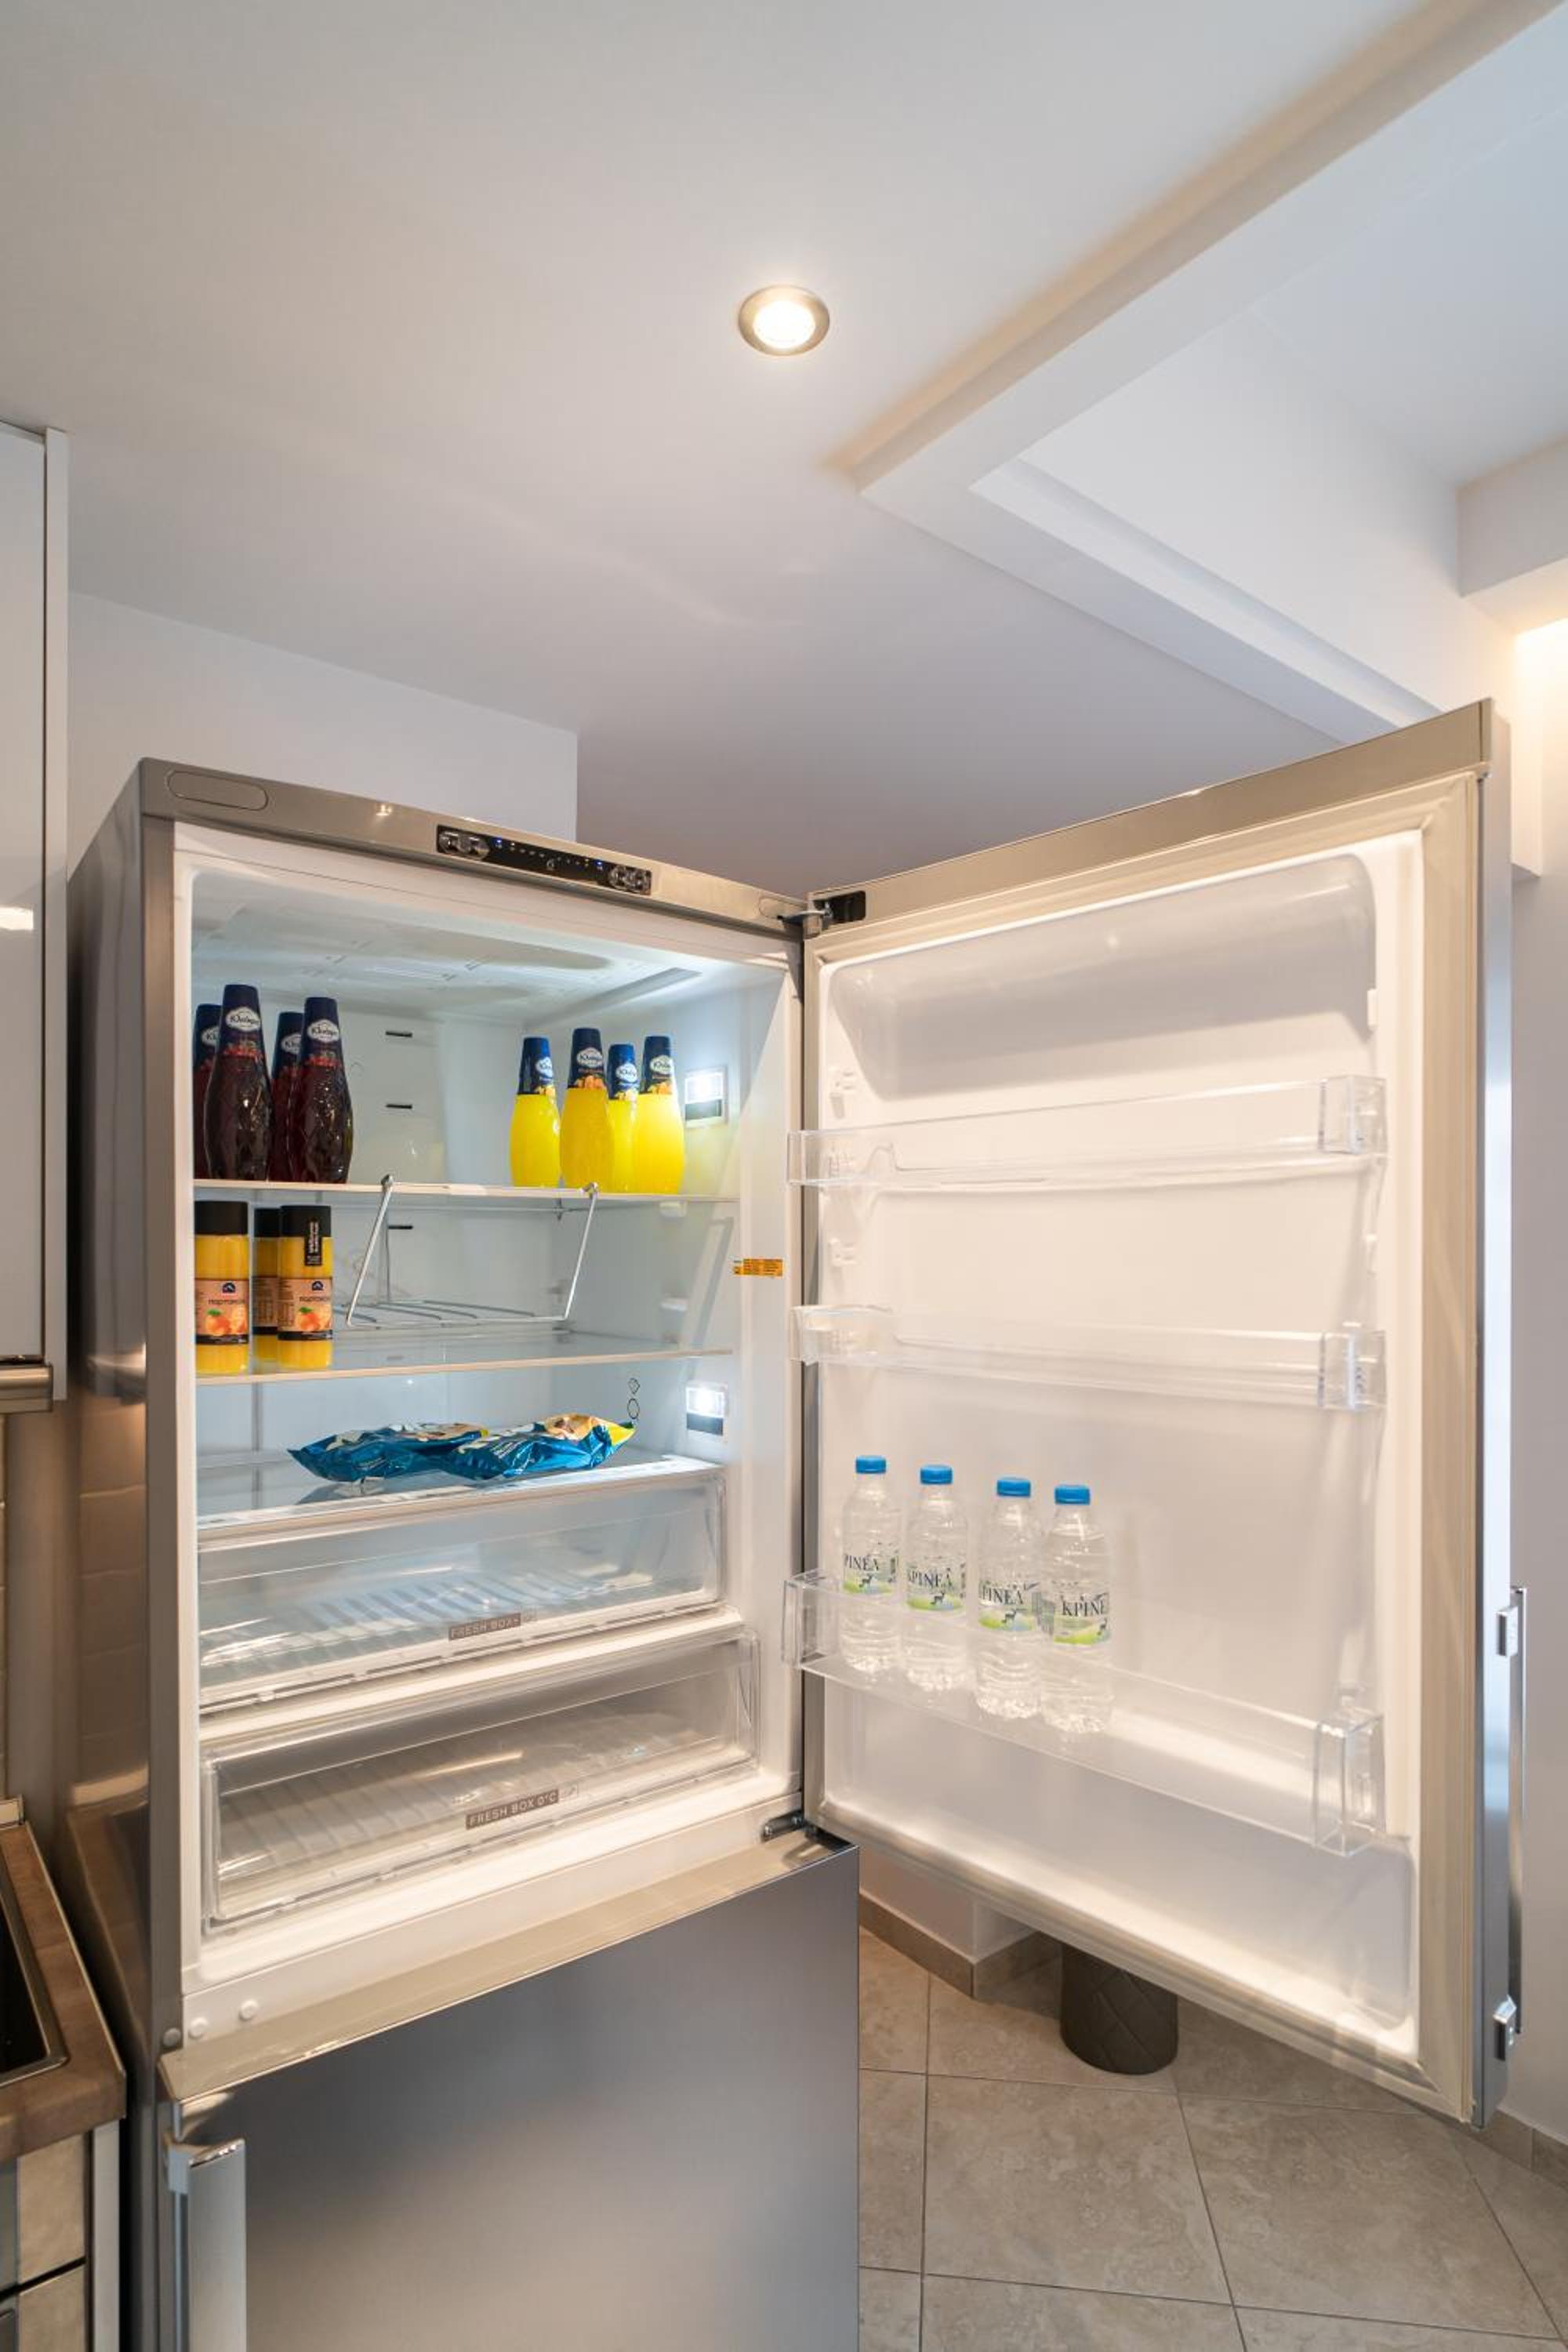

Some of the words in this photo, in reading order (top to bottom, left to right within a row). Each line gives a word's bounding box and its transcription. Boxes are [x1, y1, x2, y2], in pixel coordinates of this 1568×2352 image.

[451, 1619, 487, 1638] FRESH
[469, 1806, 508, 1827] FRESH
[510, 1797, 535, 1813] BOX
